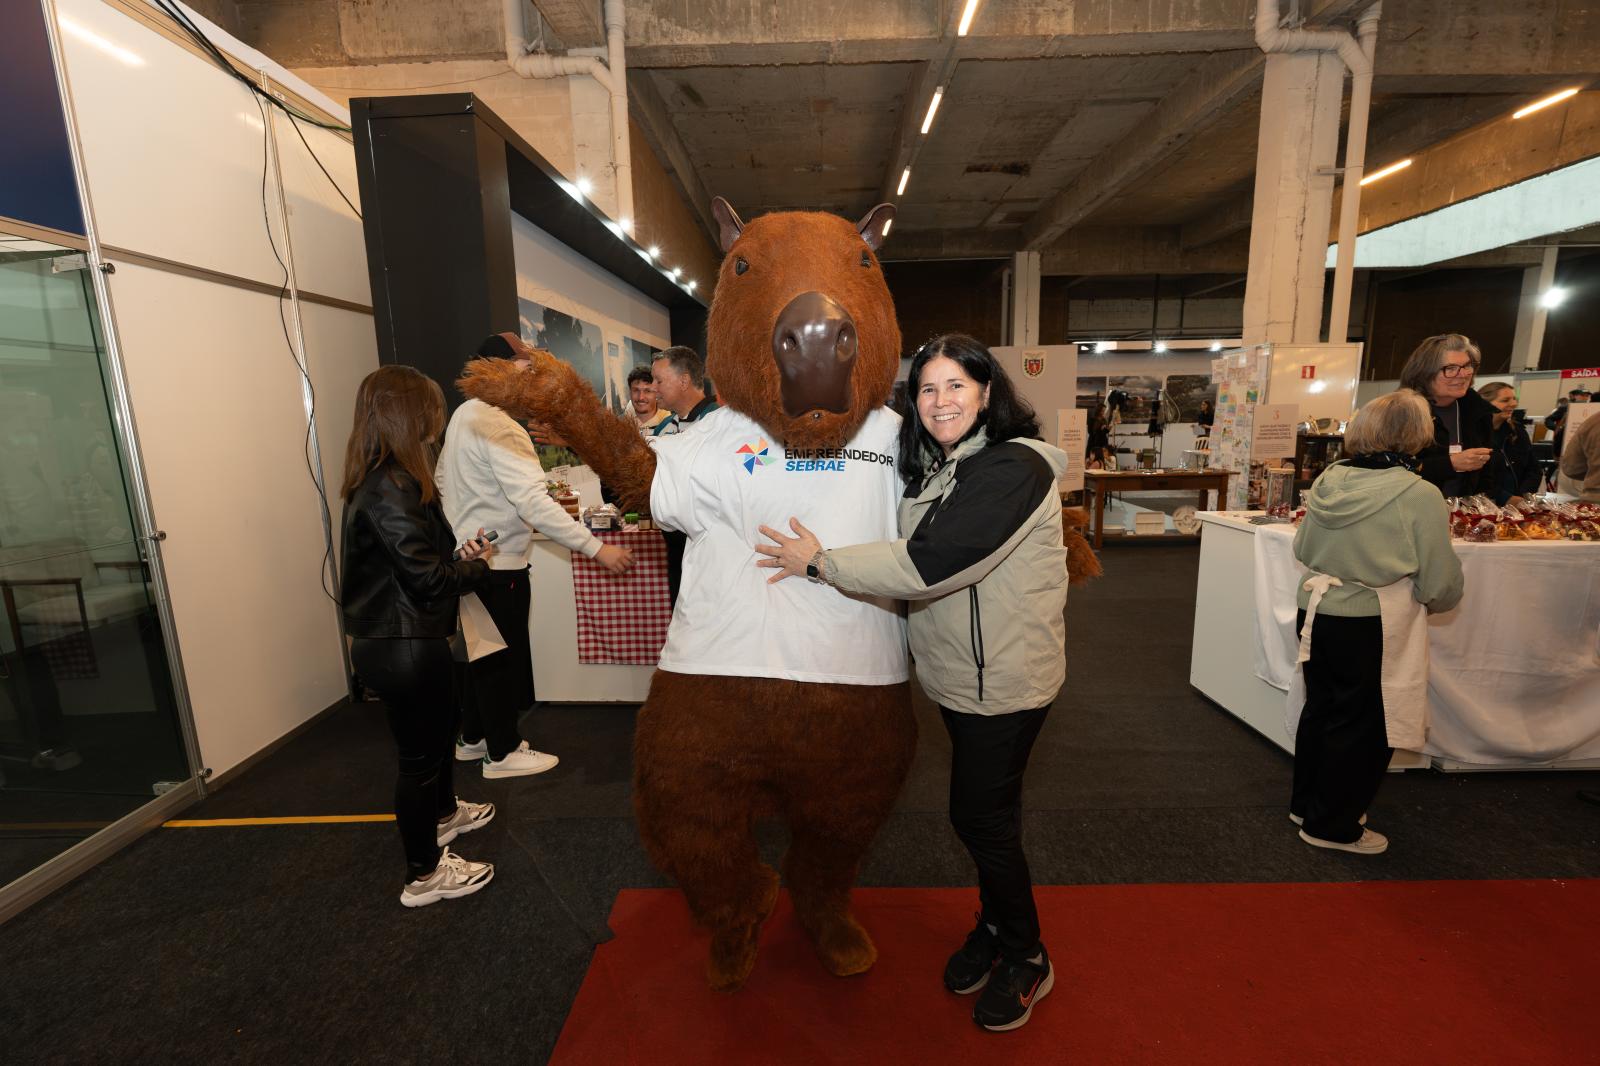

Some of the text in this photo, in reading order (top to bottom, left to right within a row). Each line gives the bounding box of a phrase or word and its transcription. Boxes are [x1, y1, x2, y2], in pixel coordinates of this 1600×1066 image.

[1571, 368, 1598, 378] SAÍDA
[784, 448, 894, 467] EMPREENDEDOR
[785, 460, 846, 472] SEBRAE
